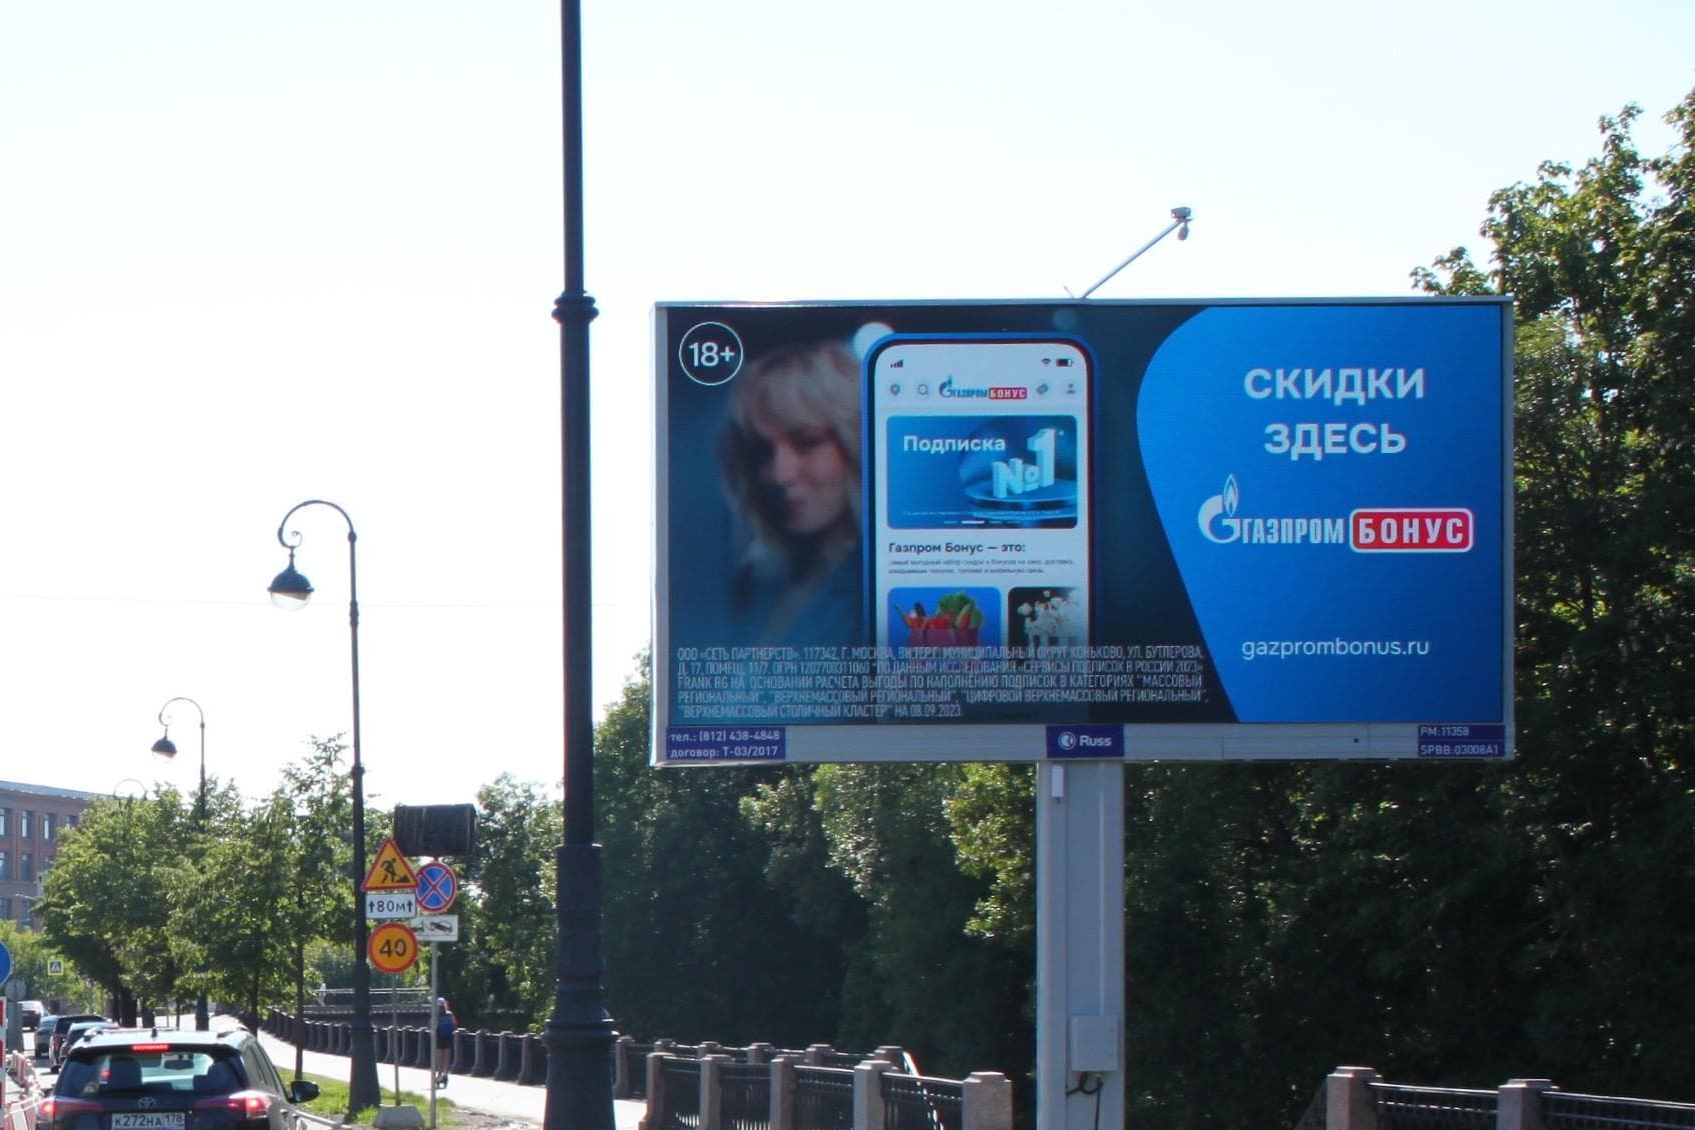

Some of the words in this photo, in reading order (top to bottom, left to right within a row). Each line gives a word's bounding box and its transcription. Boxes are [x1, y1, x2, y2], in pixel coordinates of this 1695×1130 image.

[689, 342, 735, 367] 18+
[989, 388, 1027, 399] БОНУС
[1244, 368, 1425, 406] СКИДКИ
[903, 435, 1006, 455] Подписка
[1264, 423, 1407, 461] ЗДЕСЬ
[1241, 518, 1344, 544] ГАЗПРОМ
[1358, 518, 1464, 544] БОНУС
[888, 542, 941, 555] Газпром
[945, 542, 984, 556] Бонус
[1001, 544, 1026, 552] это:
[677, 648, 698, 660] ООО
[1037, 646, 1067, 659] ОКРУГ
[1241, 637, 1430, 660] gazprombonus.ru
[773, 662, 796, 674] ОГРН
[893, 661, 937, 673] ДАННЫМ
[939, 661, 1016, 673] ИССЛЕДОВАНИЯ
[1072, 661, 1125, 673] ПОДПИСОК
[1135, 660, 1173, 672] РОССИИ
[677, 676, 712, 689] FRANK
[714, 676, 729, 688] RG
[730, 676, 745, 688] НА
[749, 676, 814, 688] ОСНОВАНИИ
[816, 676, 859, 688] РАСЧЕТА
[862, 675, 905, 688] ВЫГОДЫ
[909, 675, 925, 688] ПО
[926, 675, 999, 688] НАПОЛНЕНИЮ
[1001, 675, 1058, 687] ПОДПИСОК
[1069, 675, 1134, 687] КАТЕГОРИЯХ
[1024, 689, 1118, 702] ВЕРХНЕМАССОВЫЙ
[779, 704, 841, 718] СТОЛИЧНЫЙ
[894, 703, 909, 717] НА
[699, 730, 727, 741] (812)
[729, 730, 780, 741] 438-4848
[1079, 735, 1113, 747] Russ
[670, 748, 720, 758] договор:
[379, 939, 407, 958] 40
